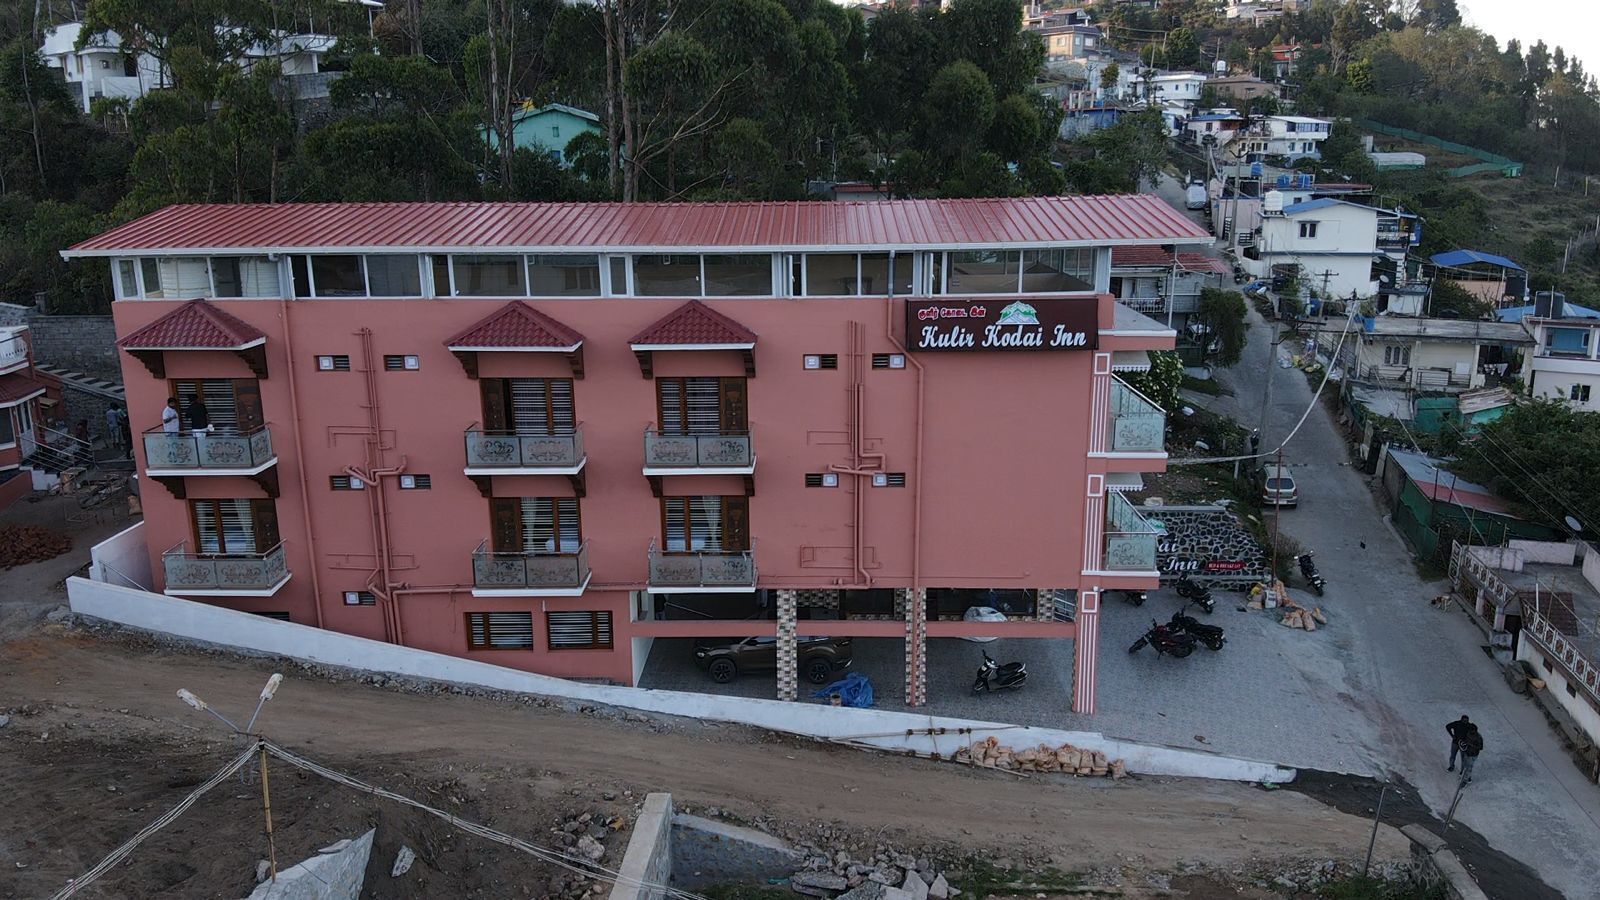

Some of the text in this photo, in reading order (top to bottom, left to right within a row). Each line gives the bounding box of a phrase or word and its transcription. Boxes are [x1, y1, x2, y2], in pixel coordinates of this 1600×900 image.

[919, 324, 1087, 348] Kulir Kodai Inn
[1163, 556, 1199, 571] Inn
